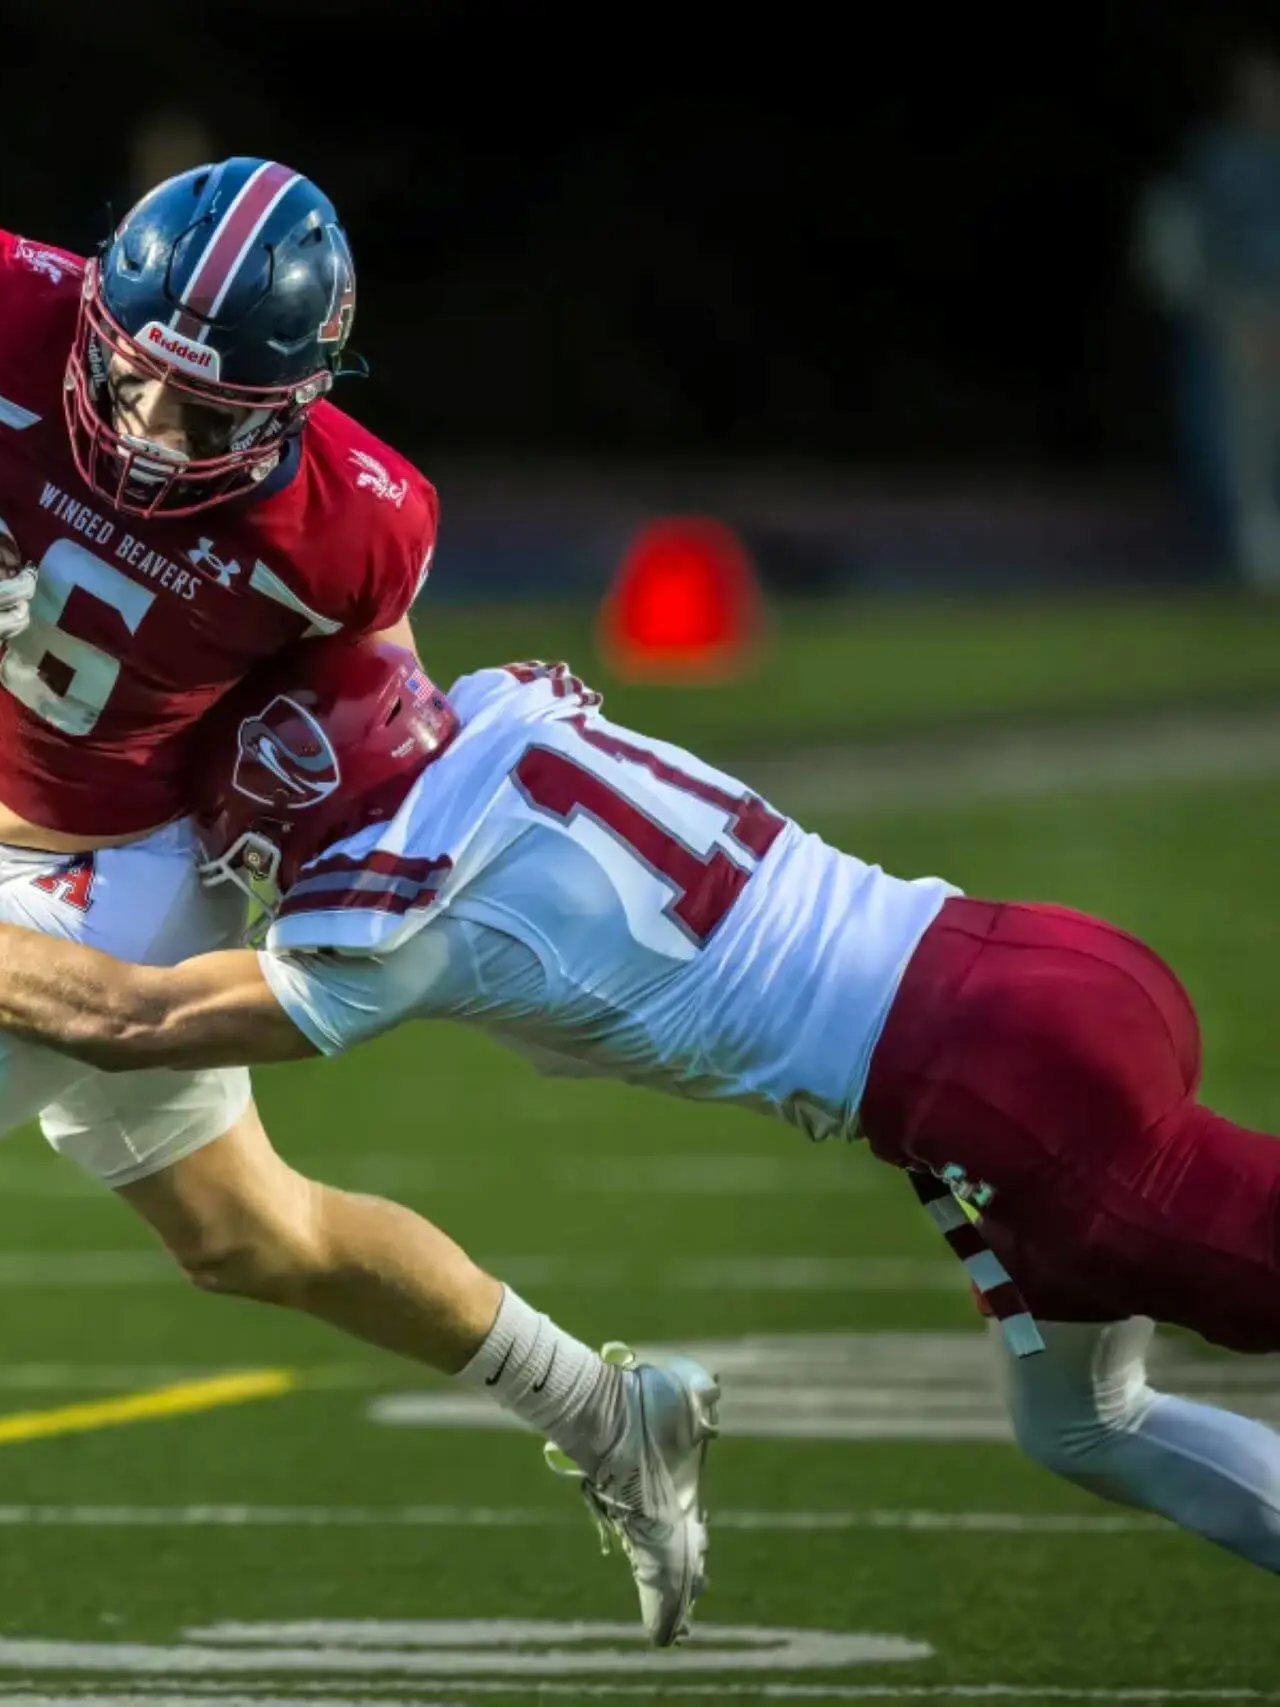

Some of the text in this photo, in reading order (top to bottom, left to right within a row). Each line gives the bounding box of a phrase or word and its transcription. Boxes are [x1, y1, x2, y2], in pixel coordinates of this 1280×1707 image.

[148, 326, 212, 368] Riddell
[38, 481, 202, 600] WINGED BEAVERS
[509, 711, 788, 952] 11
